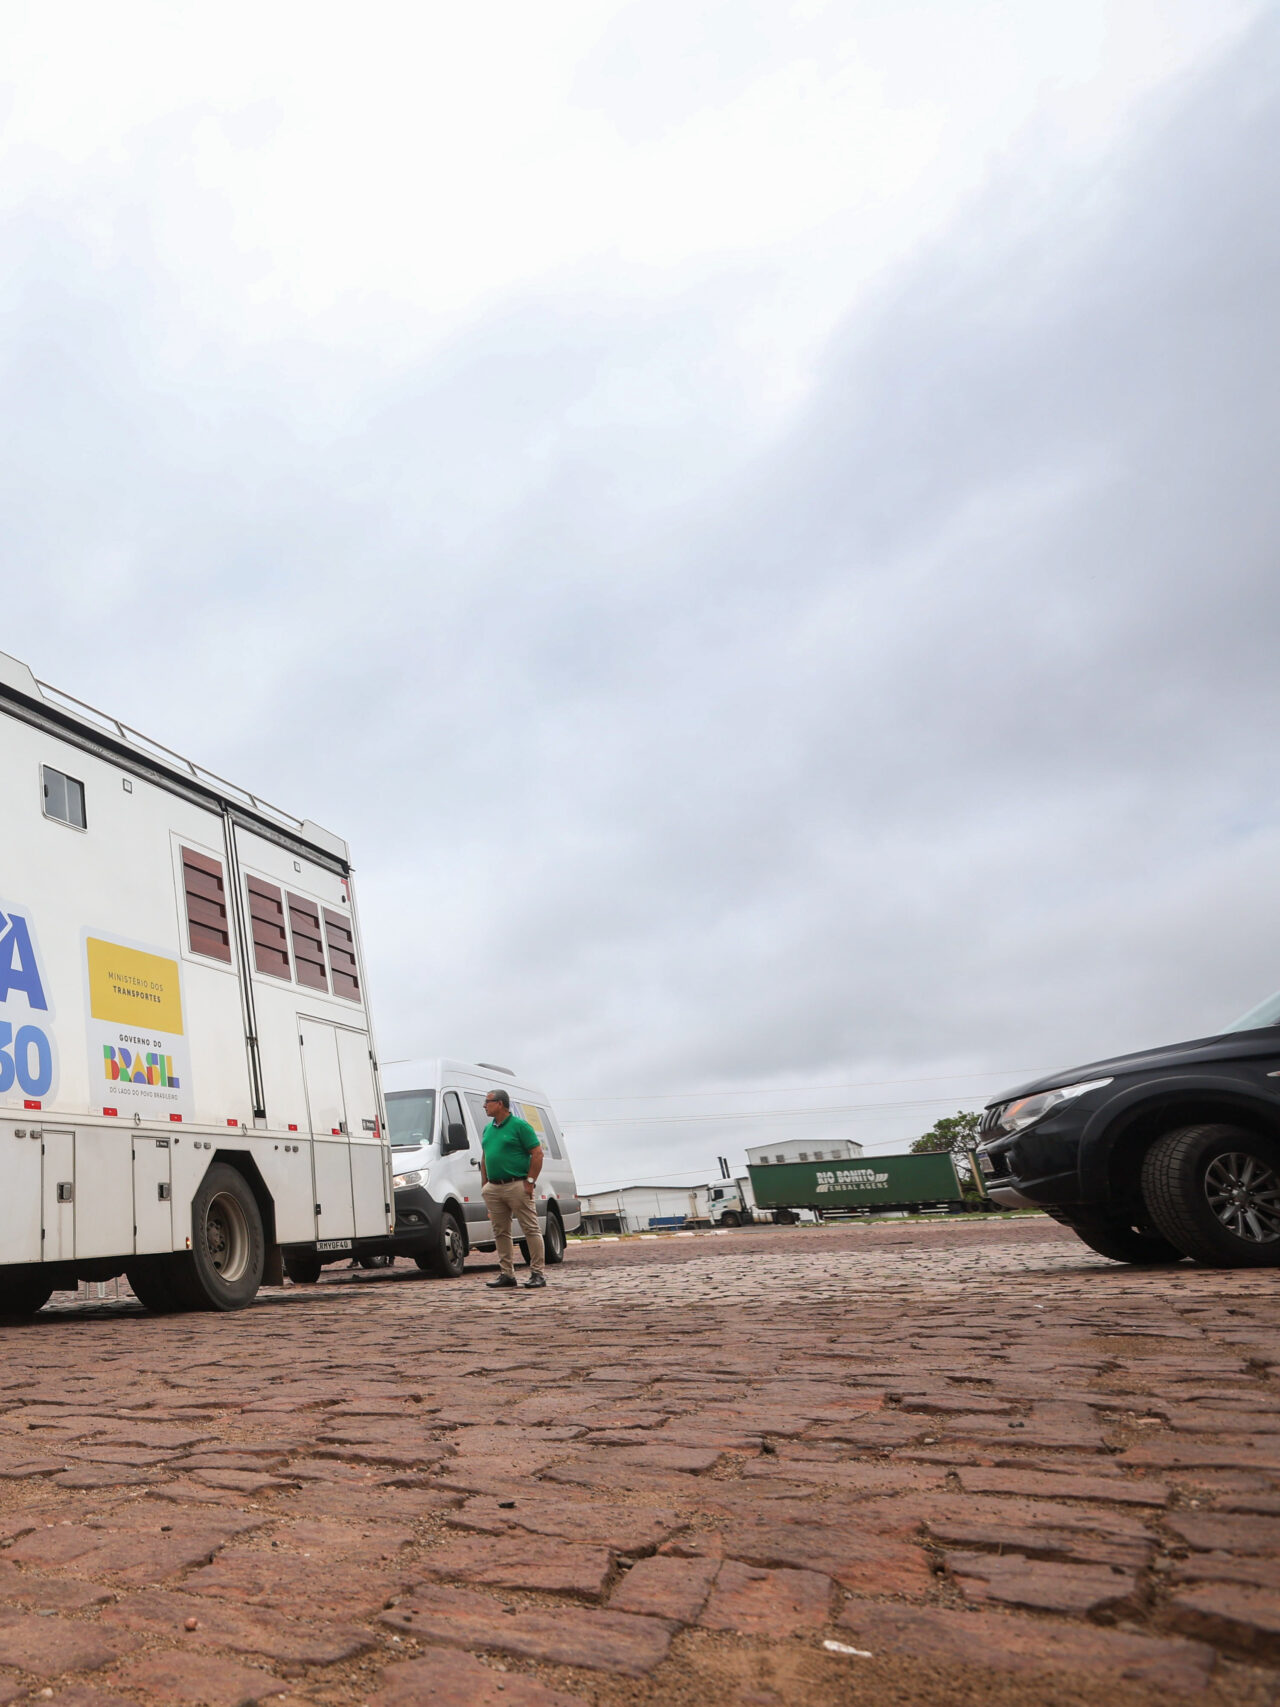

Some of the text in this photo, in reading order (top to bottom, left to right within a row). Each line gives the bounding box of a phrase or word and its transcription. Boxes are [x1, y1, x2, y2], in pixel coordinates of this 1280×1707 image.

[108, 971, 164, 992] MINISTÉRIO DOS
[113, 985, 161, 1003] TRANSPORTES
[119, 1034, 162, 1048] GOVERNO DO
[103, 1044, 180, 1089] BRASIL
[816, 1169, 875, 1184] RIO BONITO
